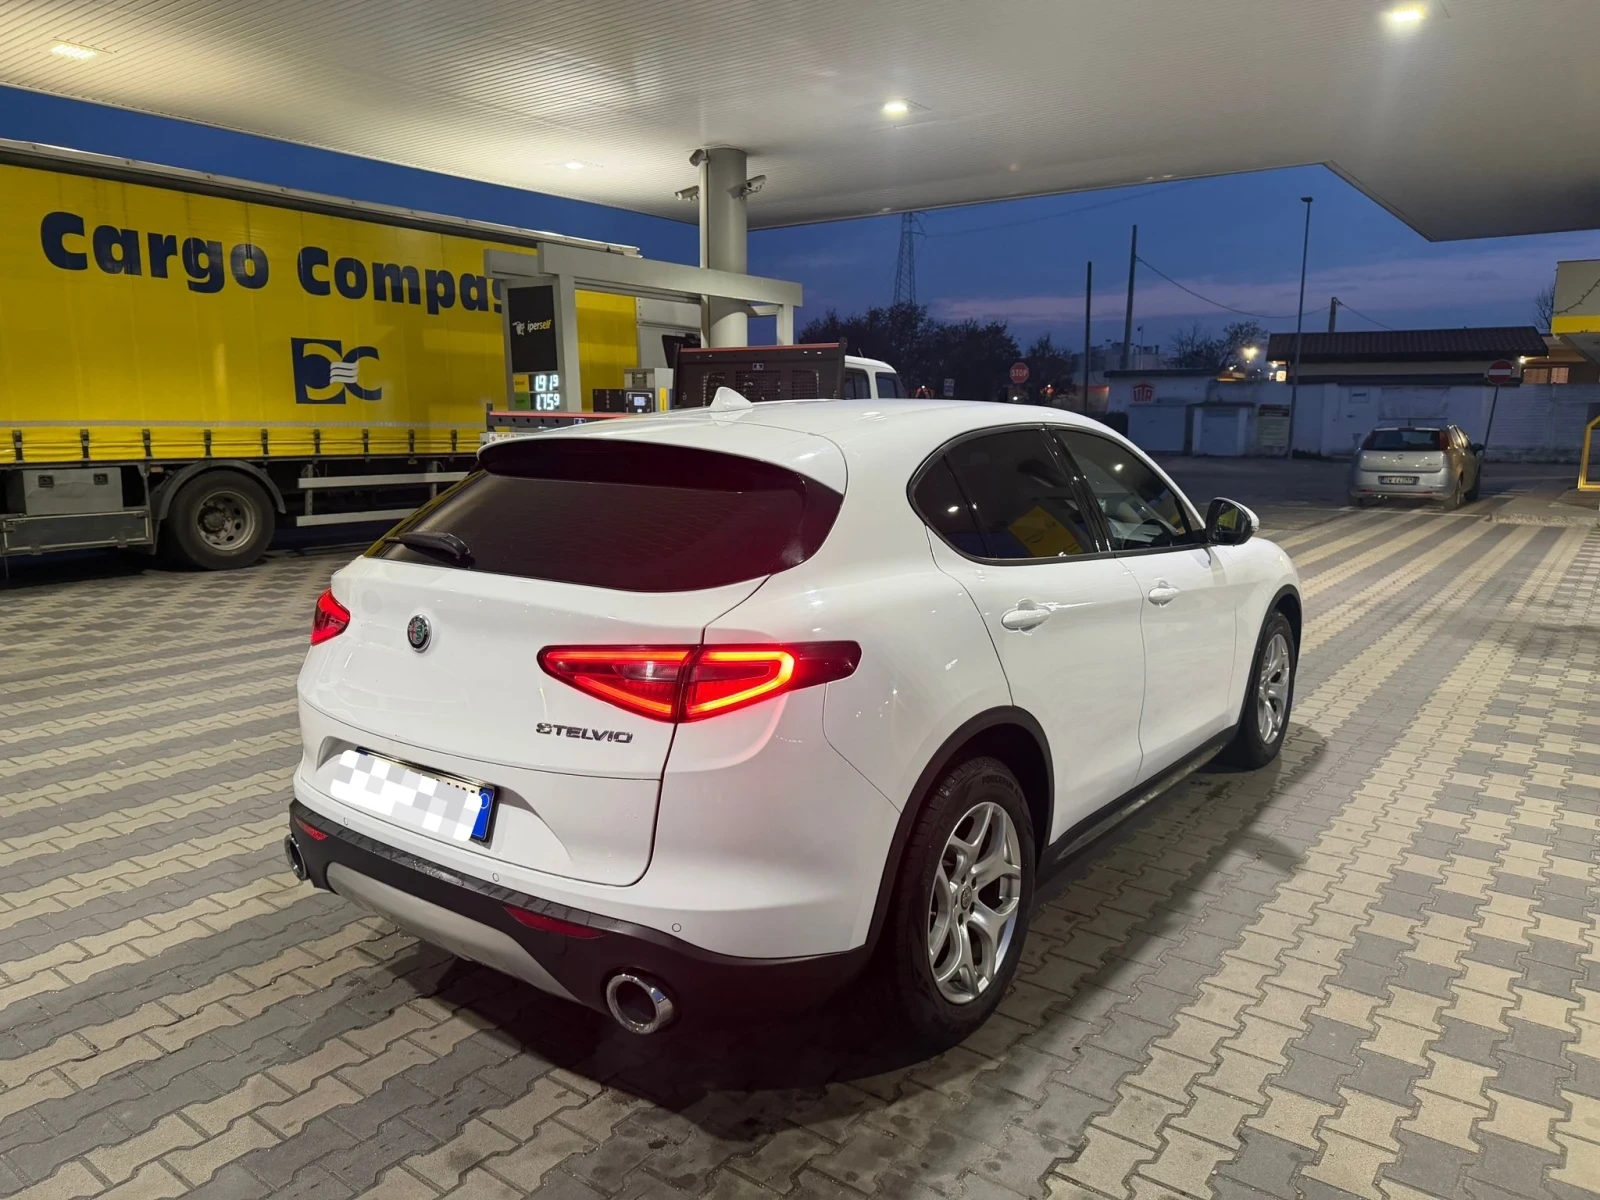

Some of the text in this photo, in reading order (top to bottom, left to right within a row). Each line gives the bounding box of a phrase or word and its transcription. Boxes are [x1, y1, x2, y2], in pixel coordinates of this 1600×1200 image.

[41, 211, 269, 293] Cargo
[527, 319, 552, 333] iperself
[1011, 368, 1028, 378] STOP
[535, 722, 634, 744] STELVIO
